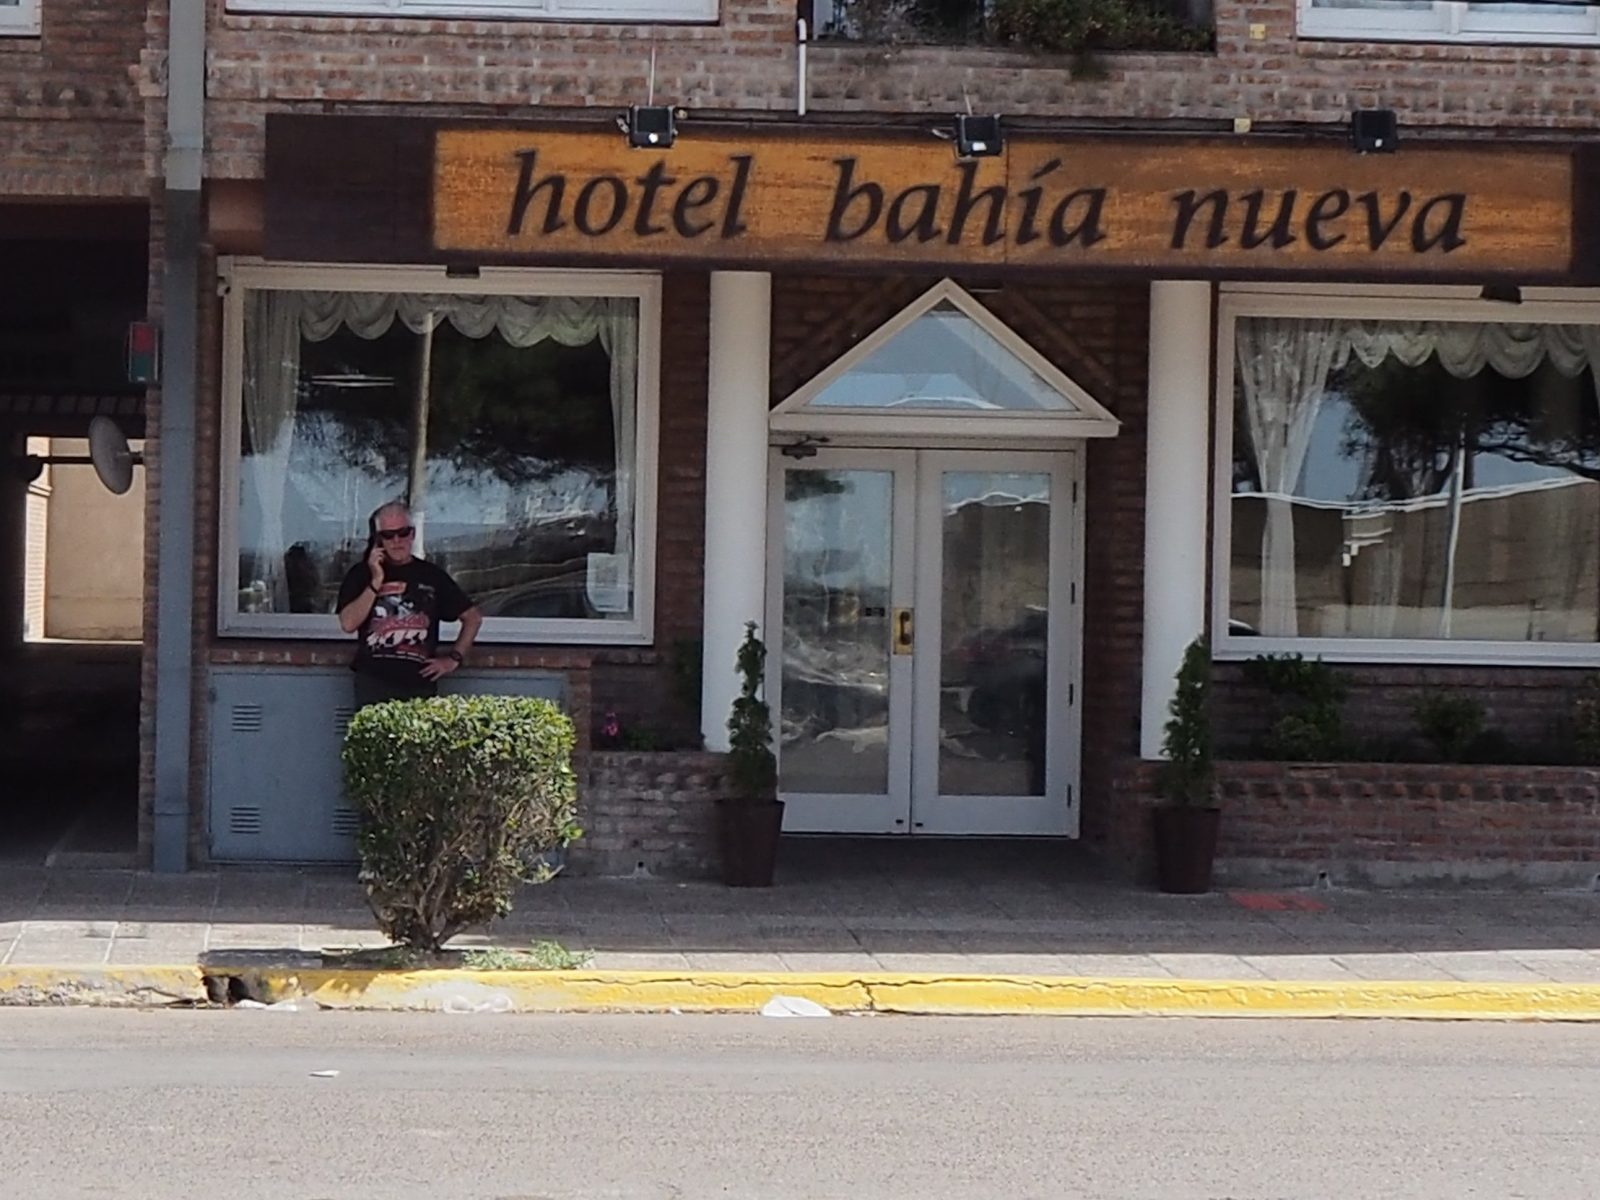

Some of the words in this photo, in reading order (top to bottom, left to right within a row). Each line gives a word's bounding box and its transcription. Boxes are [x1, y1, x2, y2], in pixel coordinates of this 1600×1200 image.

[506, 149, 752, 239] hotel
[824, 157, 1107, 248] bahía
[1170, 187, 1468, 253] nueva
